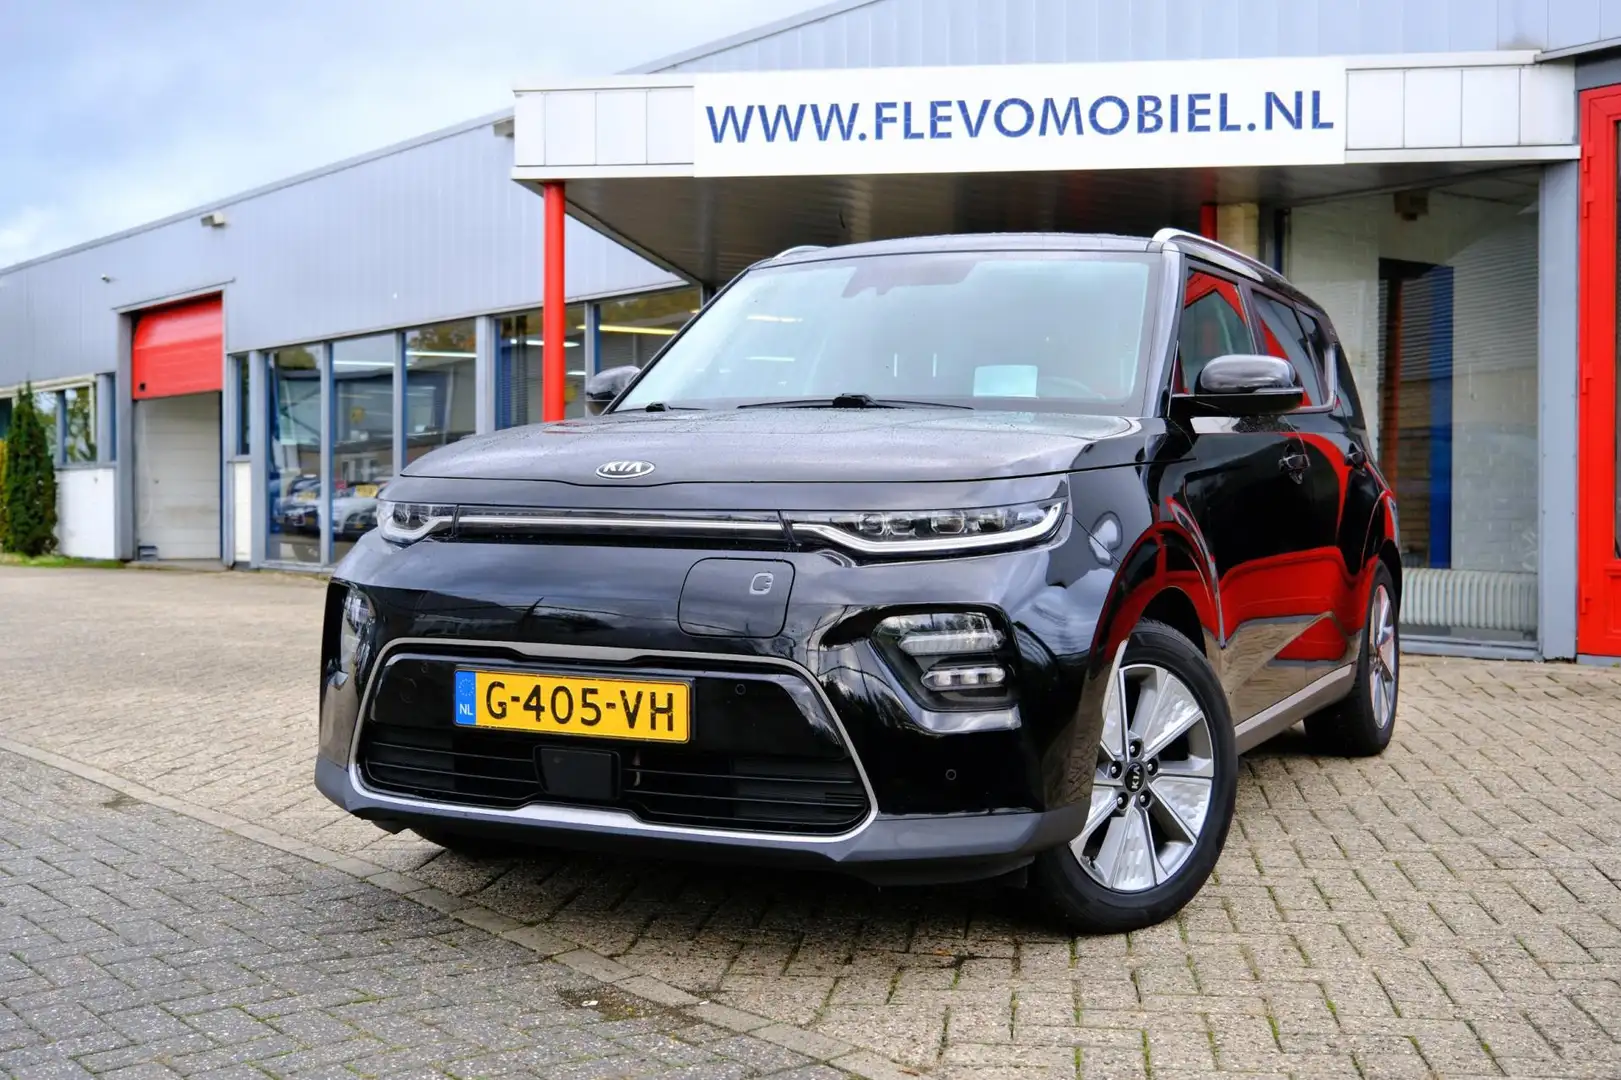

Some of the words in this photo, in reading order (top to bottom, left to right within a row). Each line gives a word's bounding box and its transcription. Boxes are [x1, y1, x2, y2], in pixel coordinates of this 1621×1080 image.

[706, 90, 1334, 143] WWW.FLEVOMOBIEL.NL
[603, 461, 642, 472] KIA
[459, 704, 473, 716] NL
[486, 681, 674, 732] G-405-VH
[1131, 766, 1140, 789] KIA
